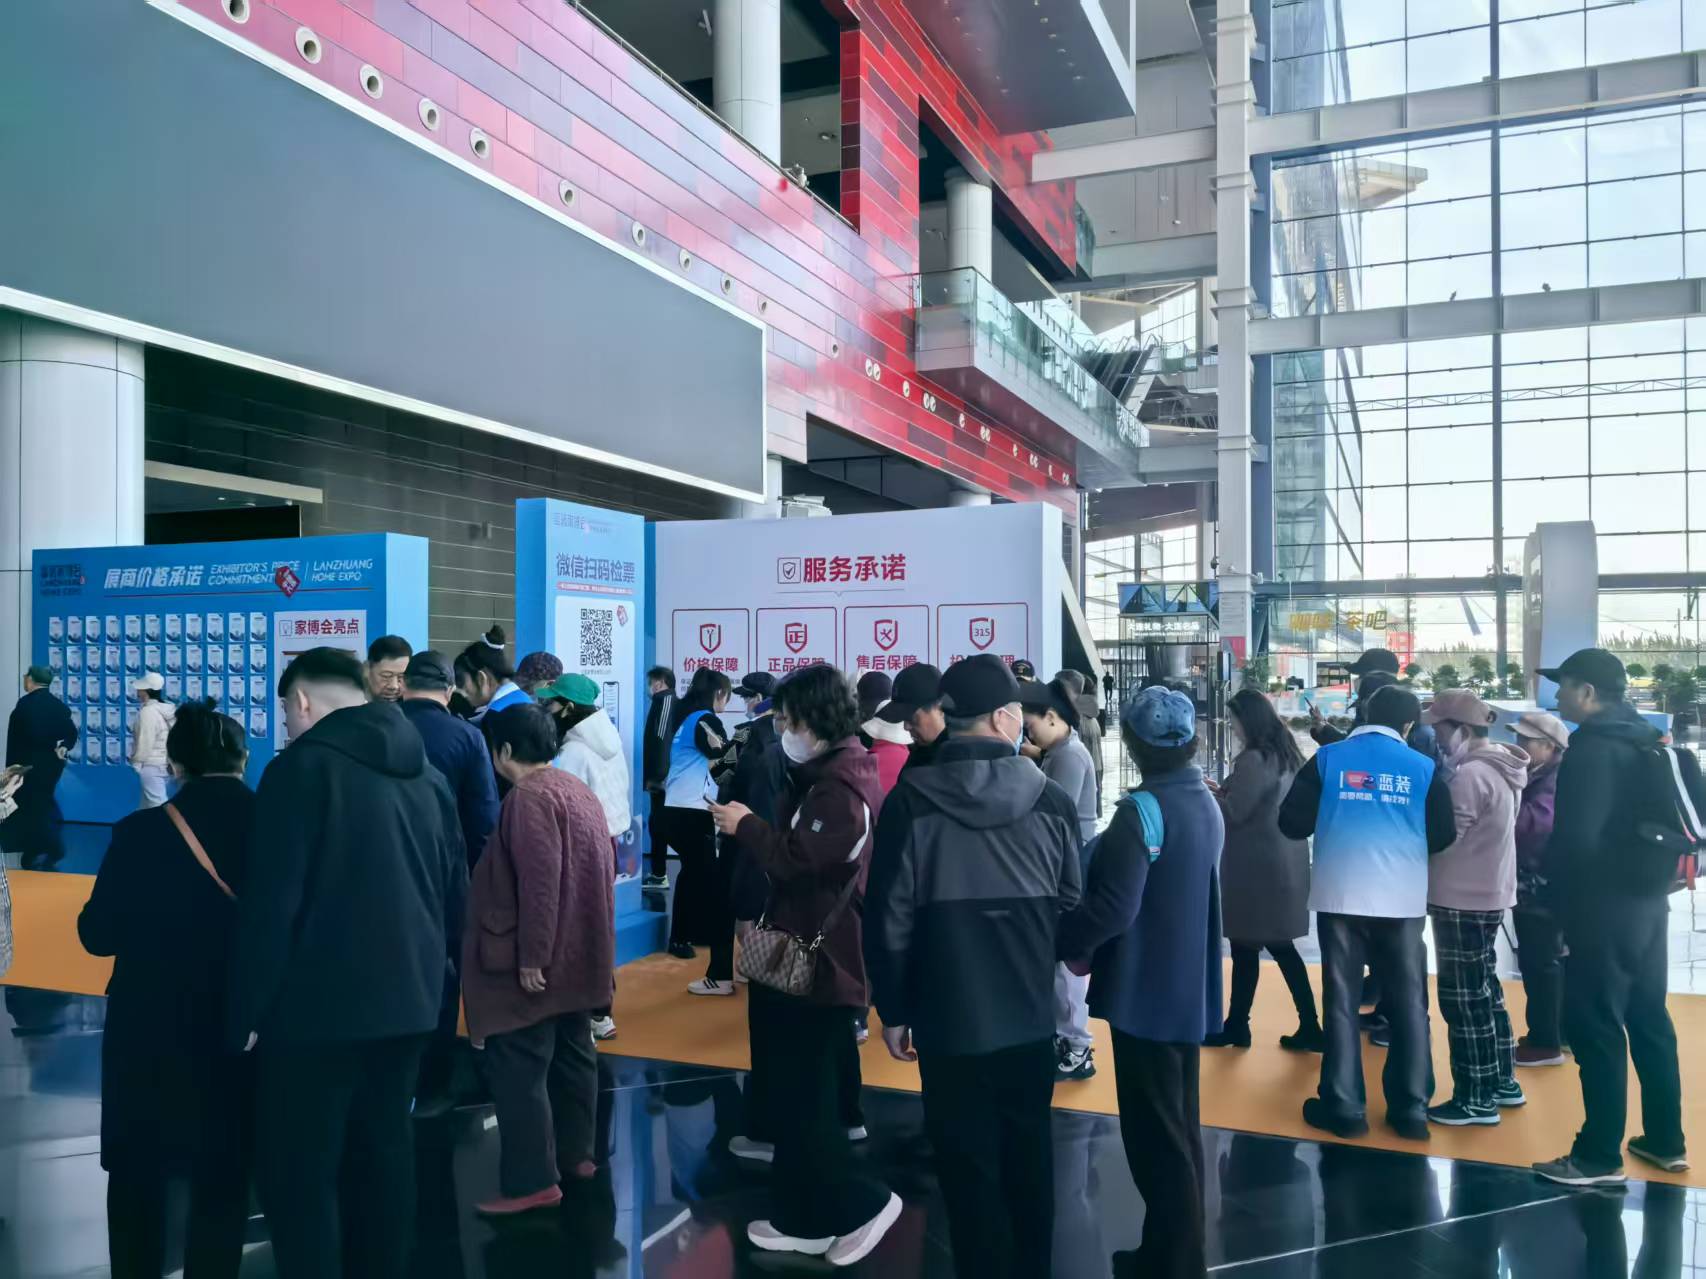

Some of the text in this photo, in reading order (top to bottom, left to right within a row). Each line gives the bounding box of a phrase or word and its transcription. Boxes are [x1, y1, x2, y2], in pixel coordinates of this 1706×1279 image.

[210, 562, 269, 575] EXHIBITOR'S
[312, 558, 374, 572] LANZHUANG
[556, 552, 635, 584] 微信扫码检票
[803, 553, 907, 583] 服务承诺
[104, 565, 203, 590] 展商价格承诺
[207, 573, 276, 586] COMMITMENT
[311, 571, 361, 582] HOME EXPO
[294, 618, 360, 636] 家博会亮点
[973, 628, 991, 638] 315
[684, 657, 739, 672] 价格保障
[1378, 773, 1411, 794] 蓝装
